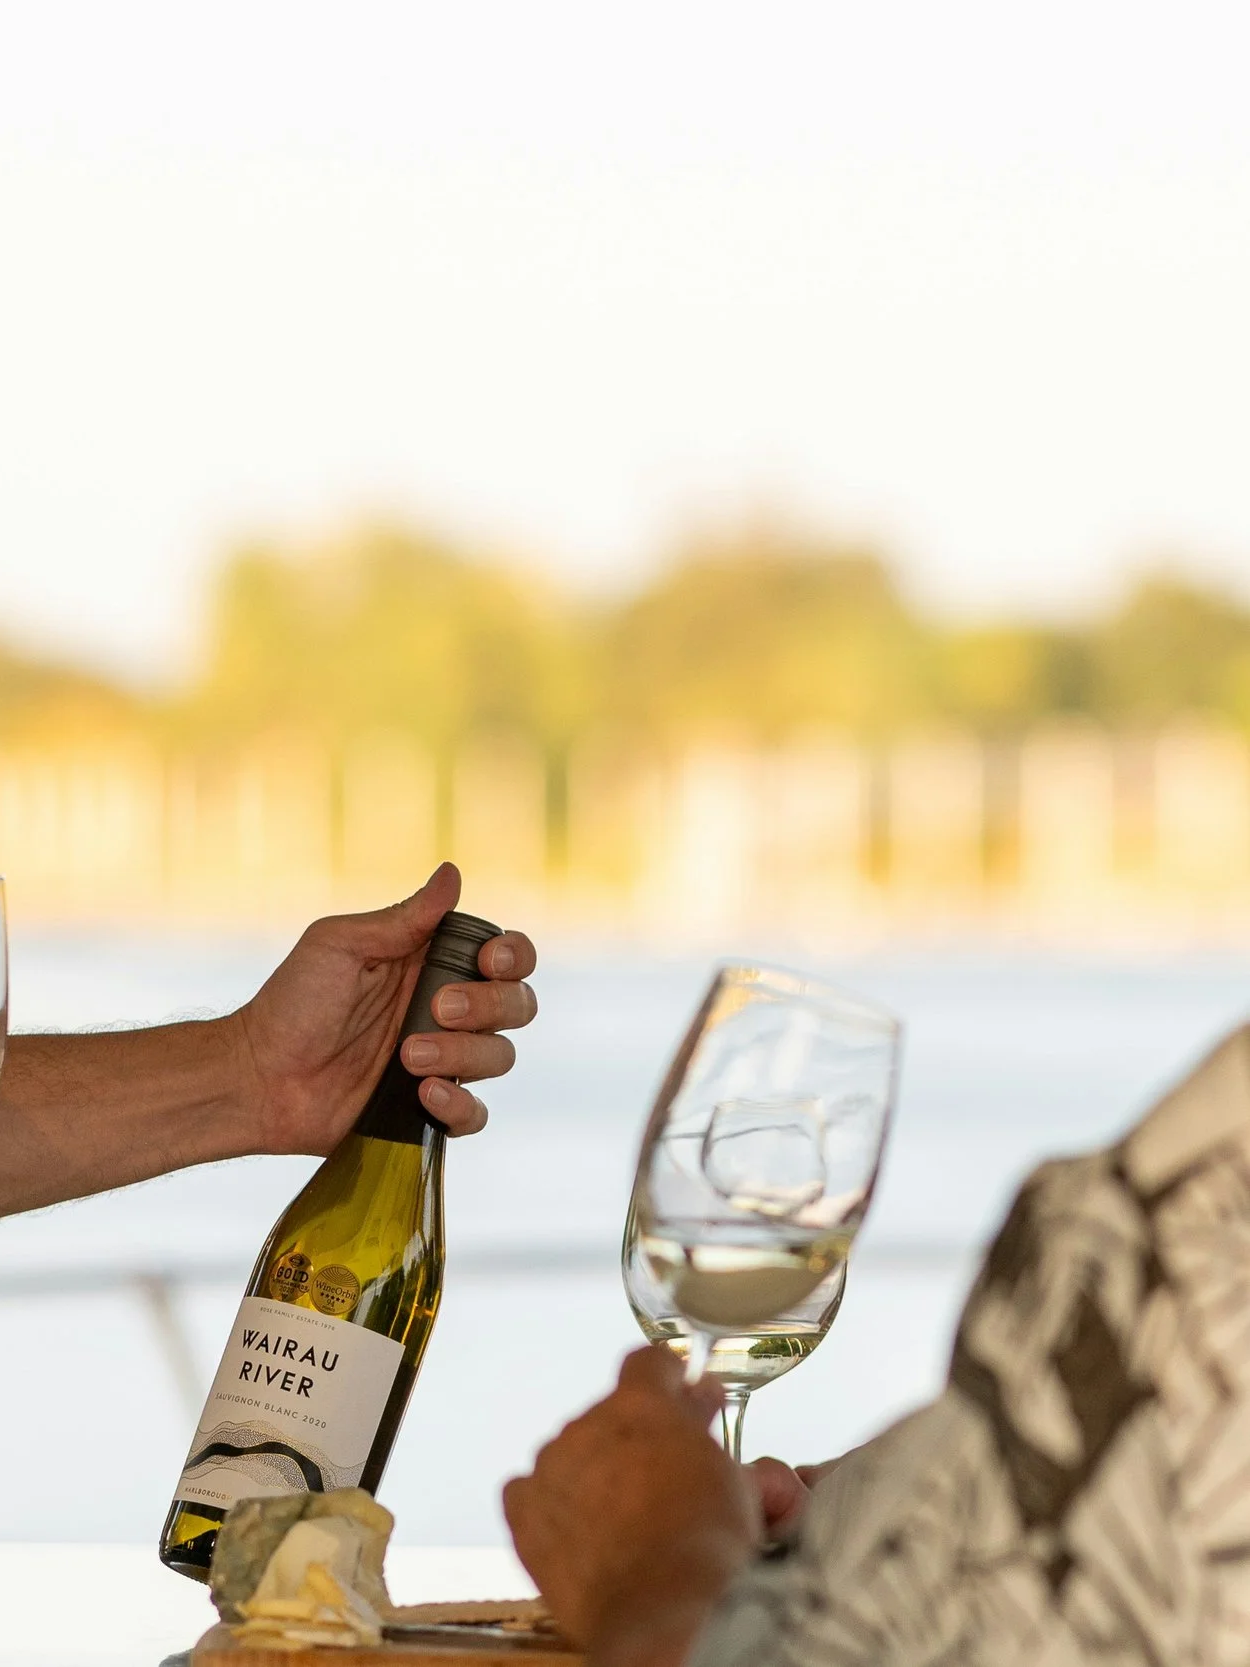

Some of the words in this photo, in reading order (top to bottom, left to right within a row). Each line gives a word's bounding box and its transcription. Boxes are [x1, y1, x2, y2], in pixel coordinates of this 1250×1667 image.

[277, 1266, 309, 1283] GOLD
[316, 1280, 357, 1301] WineOrbit
[274, 1309, 294, 1318] FAMILY
[296, 1315, 319, 1326] ESTATE
[242, 1329, 339, 1372] WAIRAU
[238, 1360, 314, 1399] RIVER
[215, 1392, 261, 1408] SAUVIGNON
[264, 1402, 299, 1419] BLANC
[302, 1415, 327, 1429] 2020
